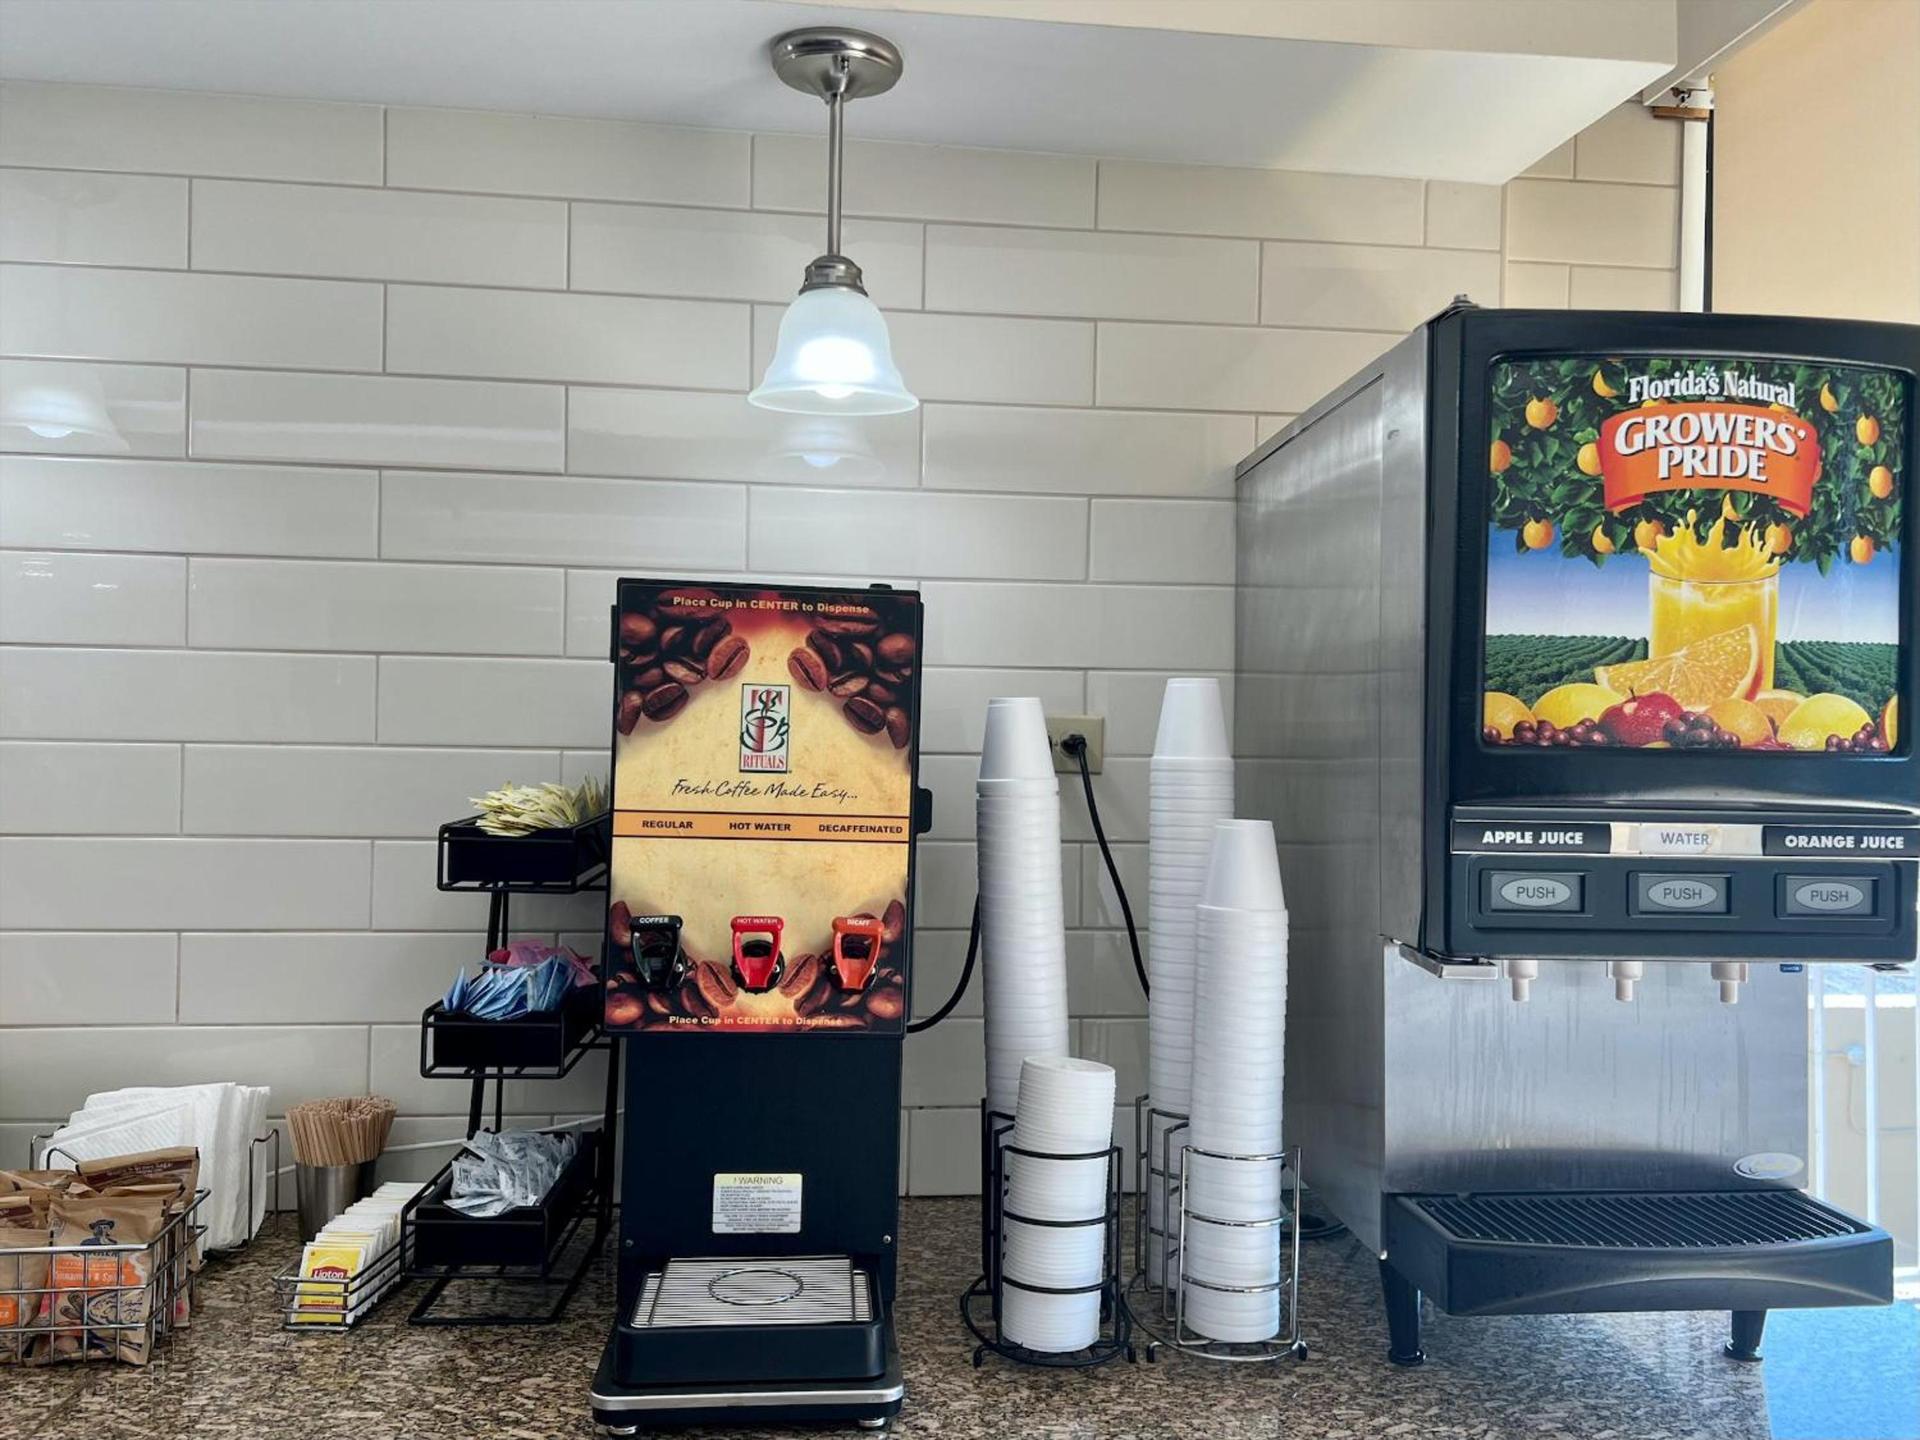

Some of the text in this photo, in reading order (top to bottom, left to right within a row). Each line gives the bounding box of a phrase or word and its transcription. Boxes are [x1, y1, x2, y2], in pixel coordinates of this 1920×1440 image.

[1628, 366, 1796, 408] Florida's Natural
[1615, 412, 1807, 456] GROWERS'
[1658, 446, 1768, 482] PRIDE
[673, 596, 706, 606] Place
[709, 598, 733, 609] Cup
[750, 600, 798, 610] CENTER
[802, 603, 813, 611] to
[817, 603, 870, 614] Dispense
[743, 754, 784, 769] RITUALS
[671, 779, 713, 796] Fresh
[715, 780, 761, 797] Coffee
[763, 782, 808, 798] Made
[642, 820, 693, 829] REGULAR
[729, 822, 791, 832] HOT WATER
[818, 823, 903, 834] DECAFFEINATED
[1482, 830, 1583, 845] APPLE JUICE
[1660, 832, 1710, 846] WATER
[1784, 835, 1904, 850] ORANGE JUICE
[1516, 886, 1555, 899] PUSH
[1663, 887, 1702, 901] PUSH
[1810, 889, 1849, 903] PUSH
[669, 1015, 698, 1024] Place
[701, 1015, 721, 1025] Cup
[737, 1016, 779, 1025] CENTER
[782, 1017, 792, 1025] to
[796, 1016, 842, 1027] Dispense
[738, 1176, 784, 1185] WARNING
[313, 1270, 344, 1281] Lipton
